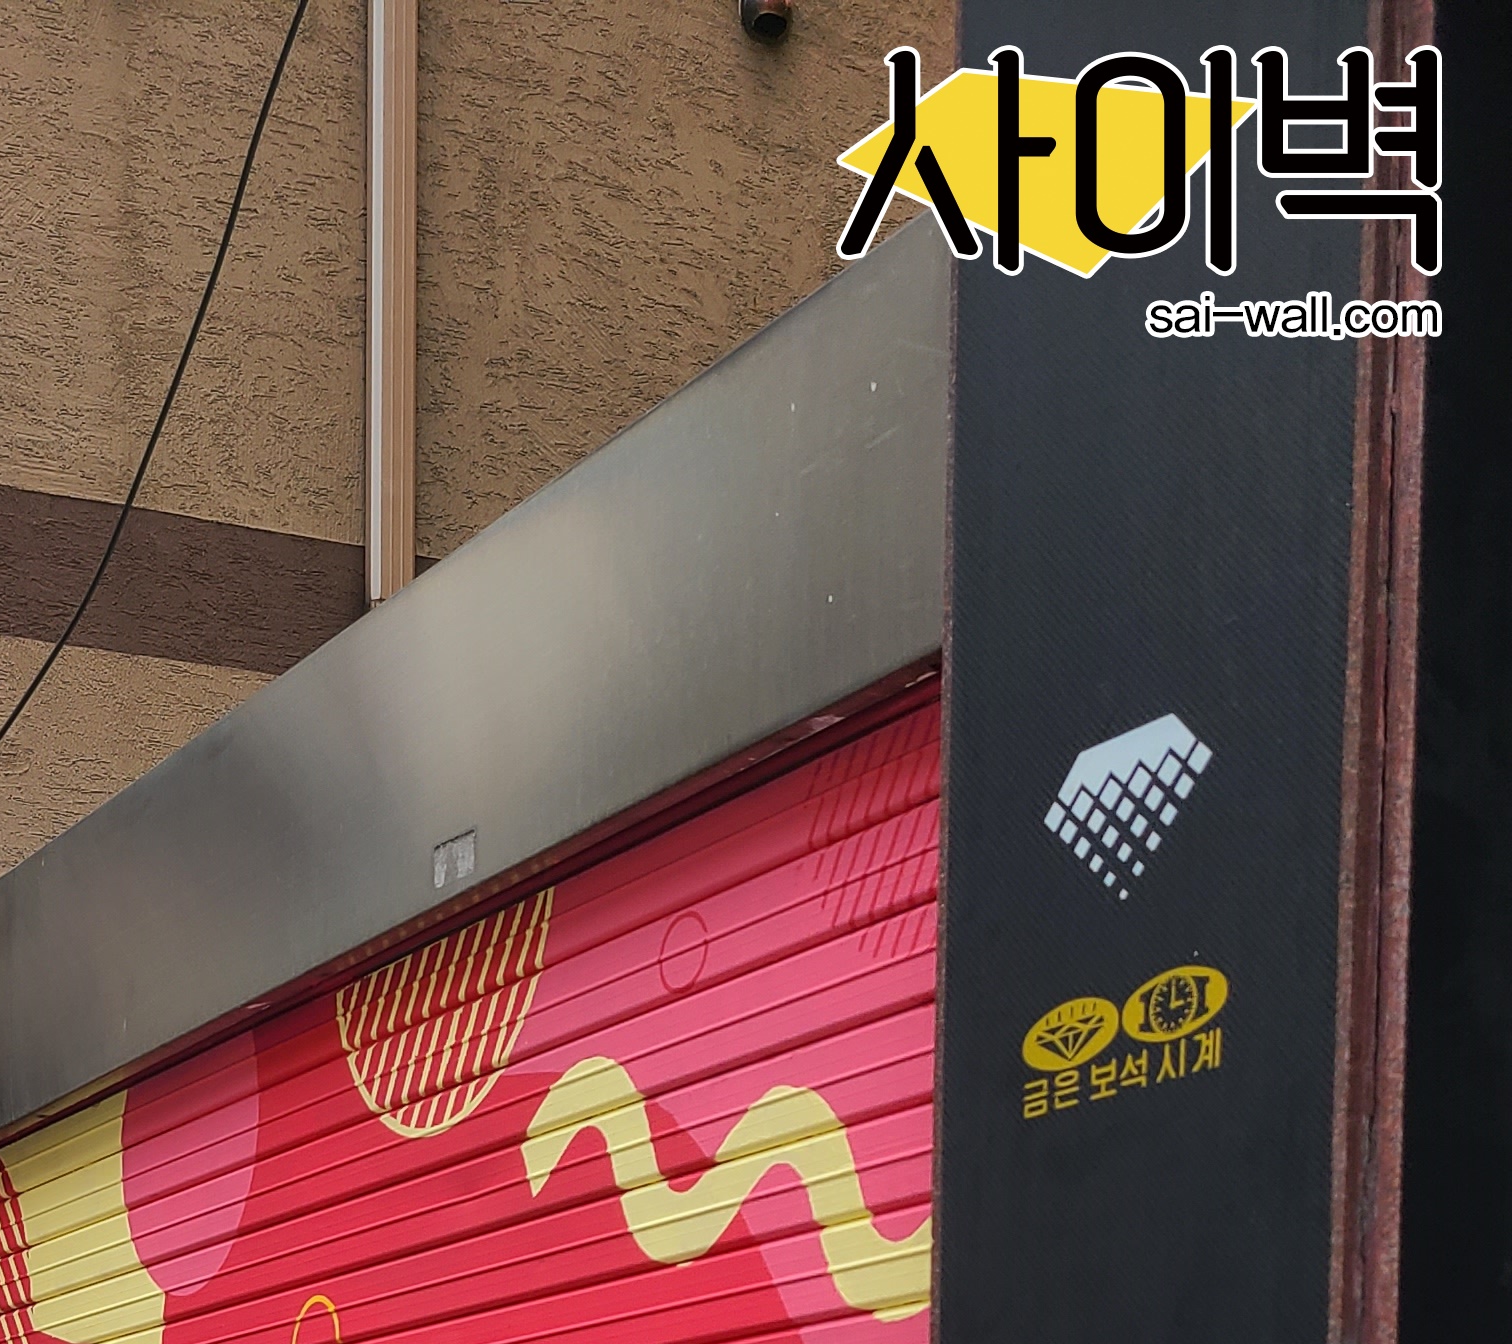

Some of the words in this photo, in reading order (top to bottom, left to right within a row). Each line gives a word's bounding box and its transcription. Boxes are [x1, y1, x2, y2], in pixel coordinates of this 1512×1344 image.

[1023, 1069, 1080, 1119] 금은
[1089, 1048, 1148, 1101] 보석
[1156, 1026, 1223, 1083] 시계
